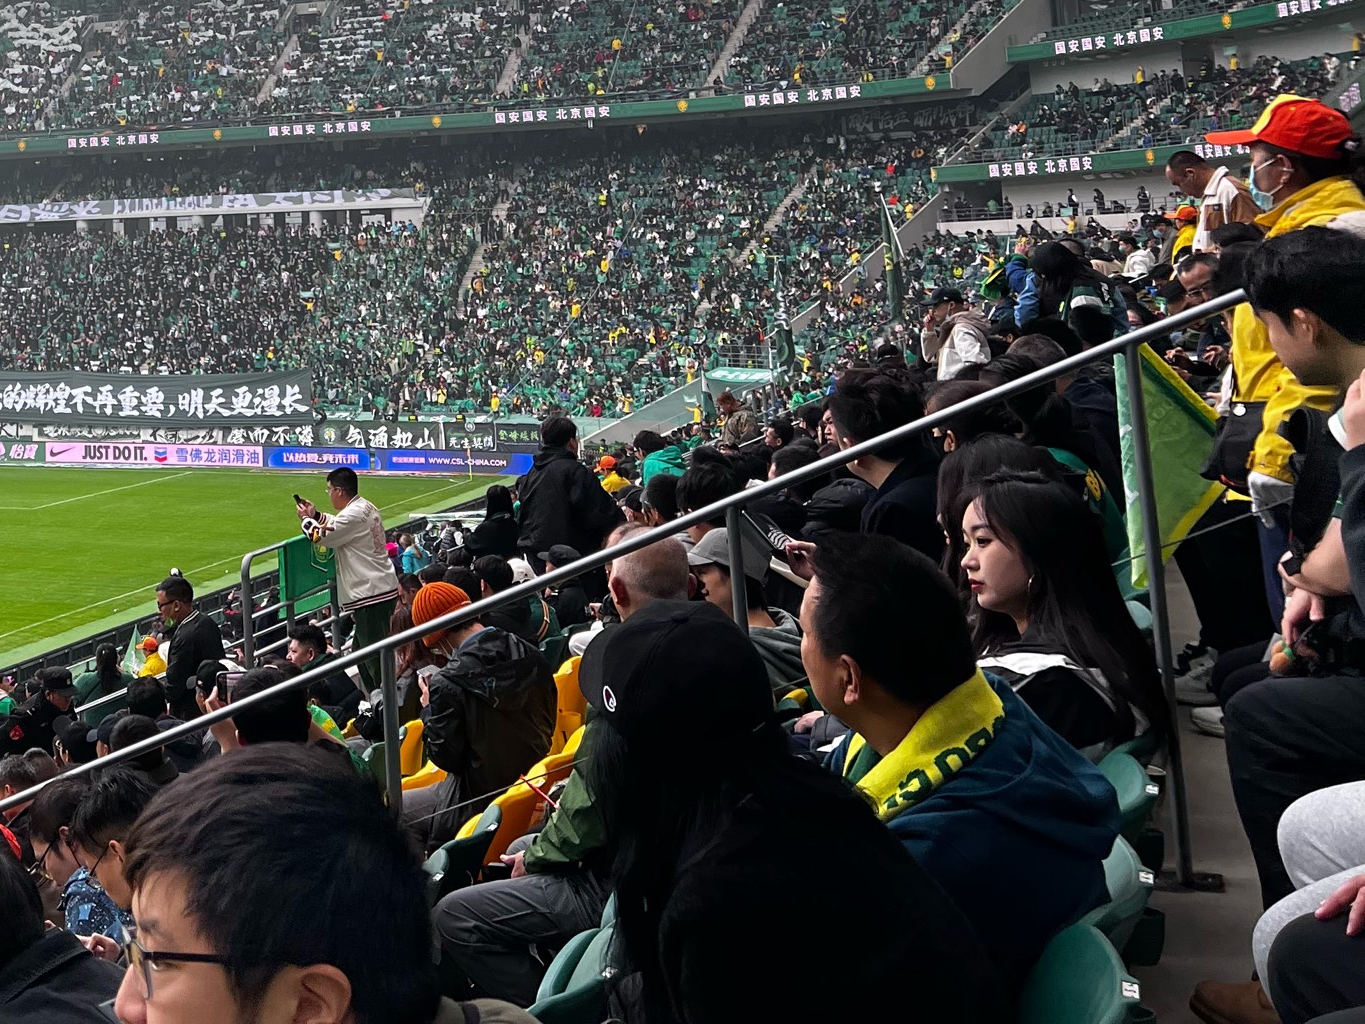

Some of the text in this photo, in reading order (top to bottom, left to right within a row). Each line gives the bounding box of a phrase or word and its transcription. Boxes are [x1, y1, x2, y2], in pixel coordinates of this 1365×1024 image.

[1055, 26, 1164, 55] 国安国安 北京国安
[745, 85, 861, 108] 国安国安 北京国安
[494, 105, 610, 124] 国安国安 北京国安
[268, 120, 371, 137] 国安国安 北京国安
[68, 133, 159, 148] 国安国安 北京国安
[989, 156, 1093, 178] 国安国安 北京国安
[82, 445, 148, 461] JUST DO IT.
[175, 448, 260, 465] 雪佛龙润滑油
